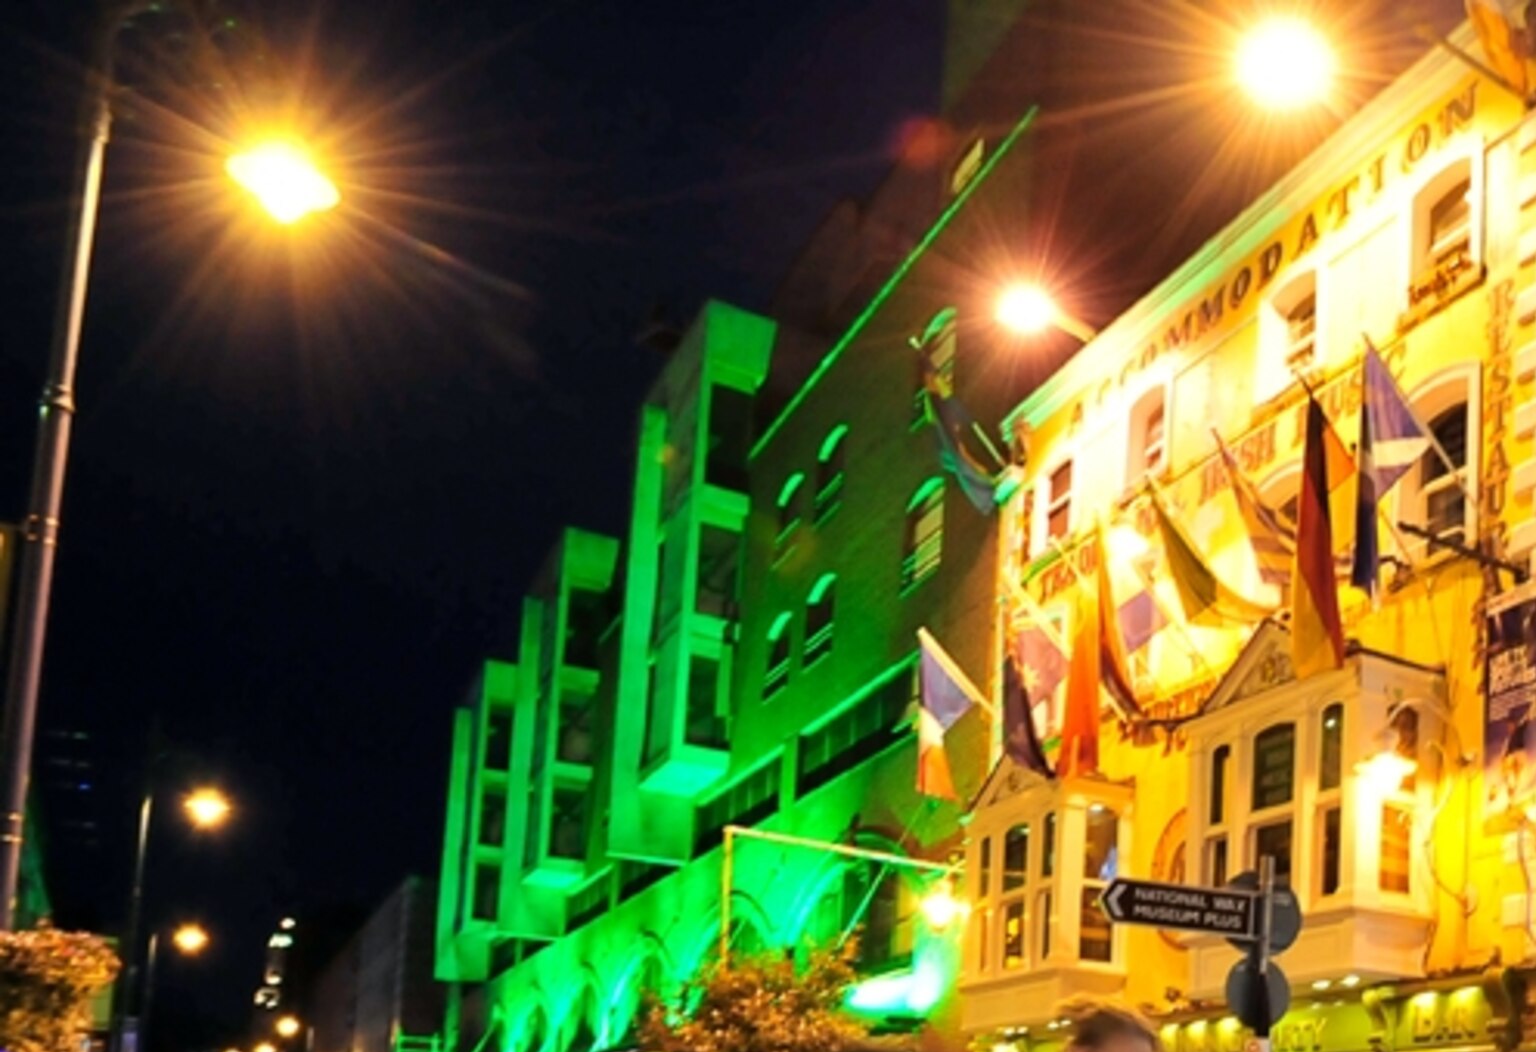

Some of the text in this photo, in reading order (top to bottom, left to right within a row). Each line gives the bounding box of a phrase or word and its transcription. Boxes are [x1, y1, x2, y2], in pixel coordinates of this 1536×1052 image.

[1200, 422, 1276, 508] IRSH
[1133, 904, 1242, 929] MUSEUM PLUS
[1134, 887, 1246, 913] NATIONAL WAX
[1412, 1002, 1477, 1044] BAR
